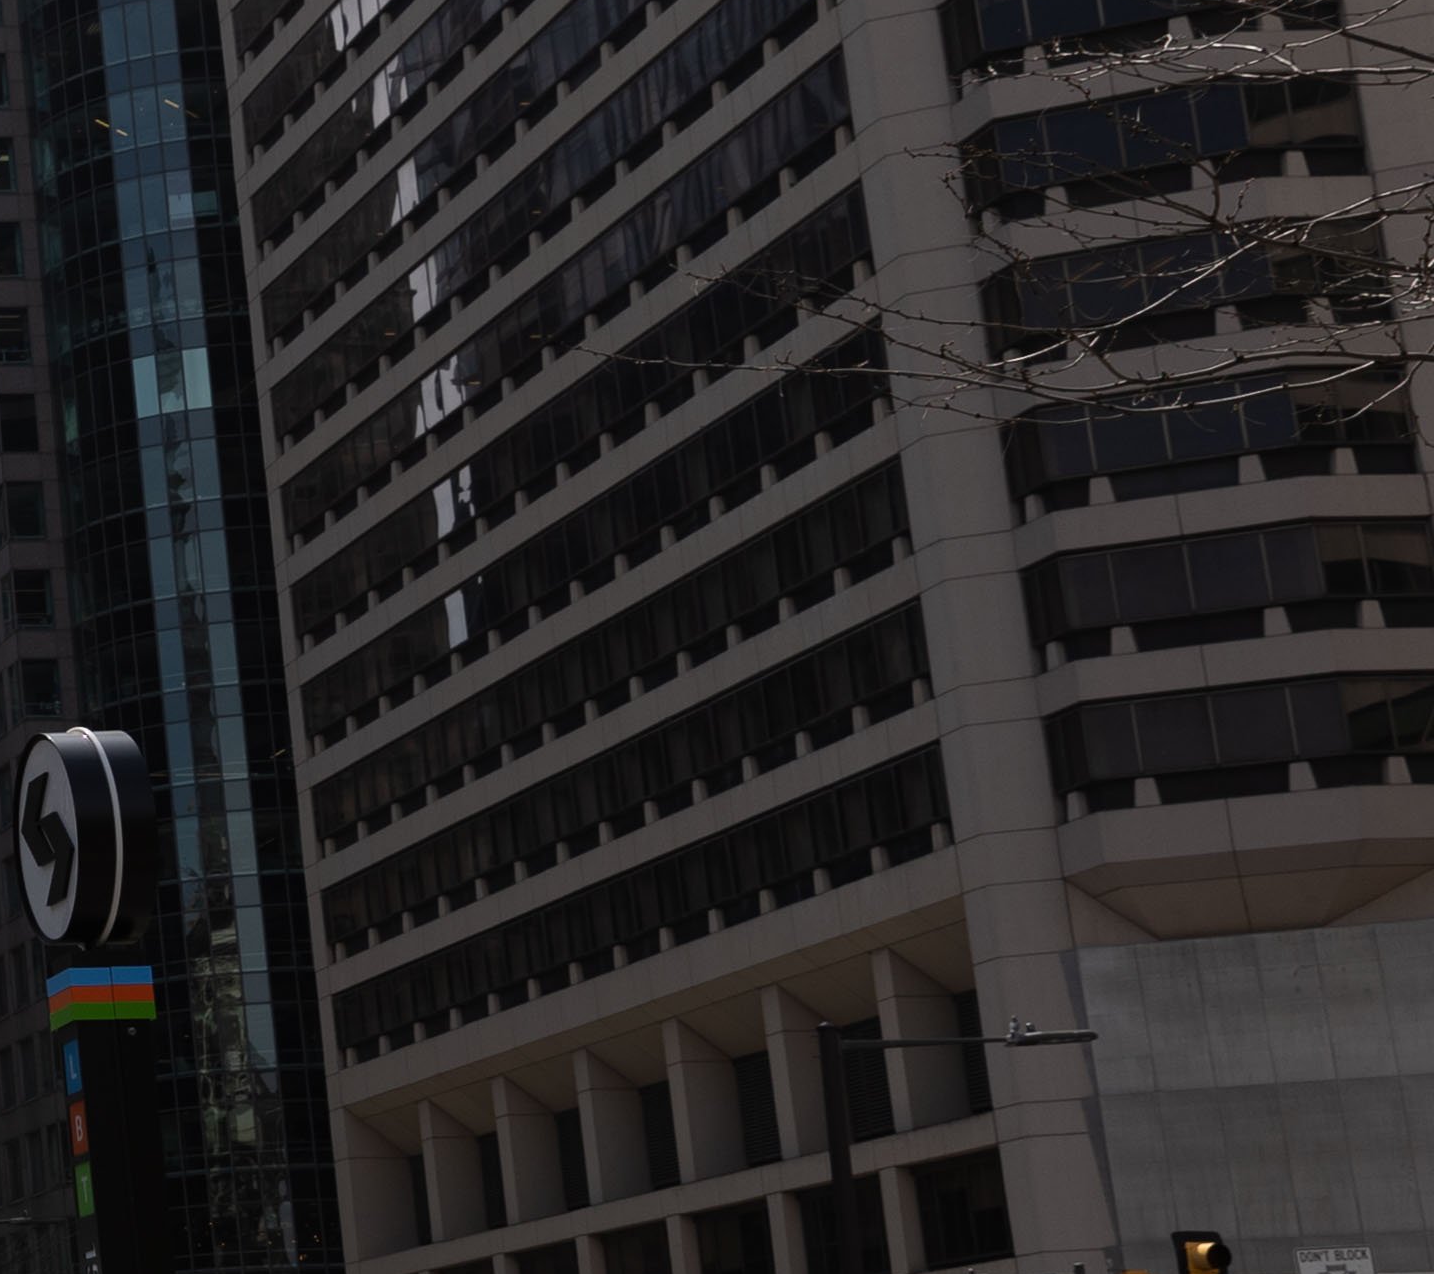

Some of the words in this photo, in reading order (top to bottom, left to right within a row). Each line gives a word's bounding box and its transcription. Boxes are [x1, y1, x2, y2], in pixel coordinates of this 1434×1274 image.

[74, 1115, 84, 1141] B
[80, 1175, 89, 1204] T
[1298, 1250, 1330, 1263] DON'T
[1334, 1249, 1369, 1262] BLOCK
